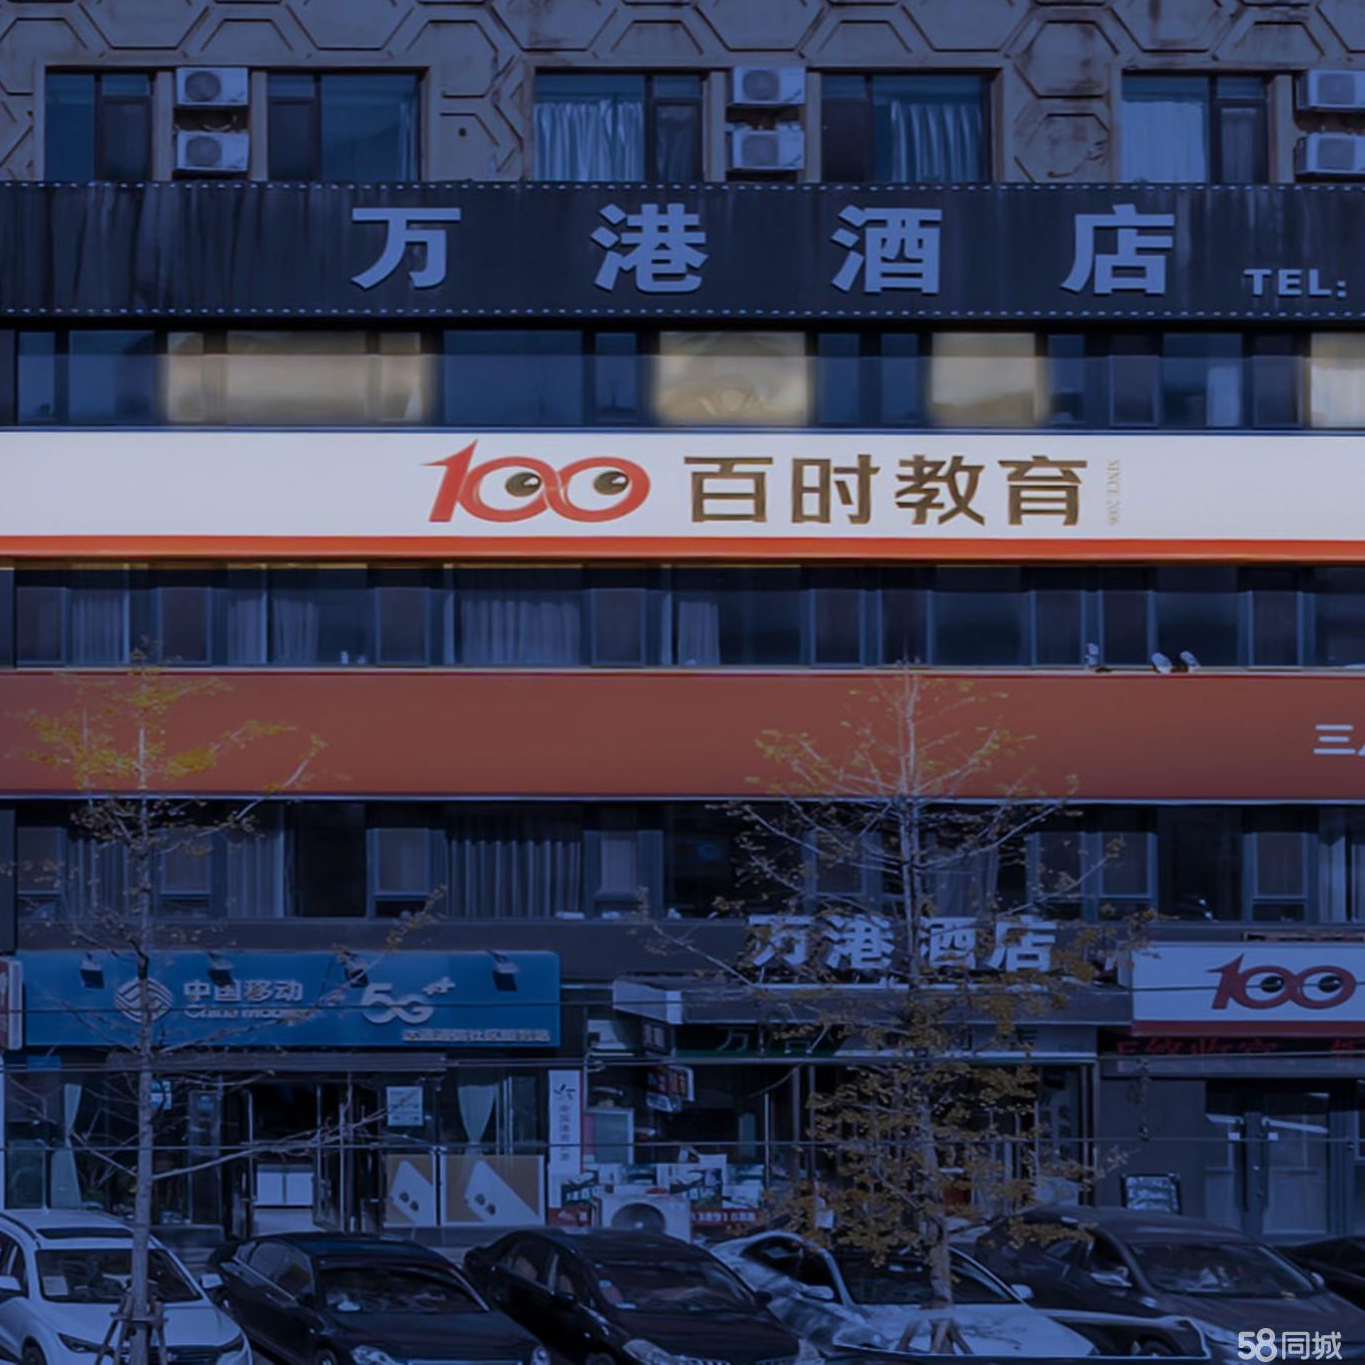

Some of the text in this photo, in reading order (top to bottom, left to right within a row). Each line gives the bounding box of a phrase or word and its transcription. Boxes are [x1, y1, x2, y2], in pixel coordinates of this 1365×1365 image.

[350, 202, 1348, 298] 万港酒店 TEL:
[683, 453, 1089, 527] 百时教育
[1311, 723, 1365, 756] 三
[747, 914, 1059, 973] 万港酒店
[182, 978, 306, 1004] 中国移动
